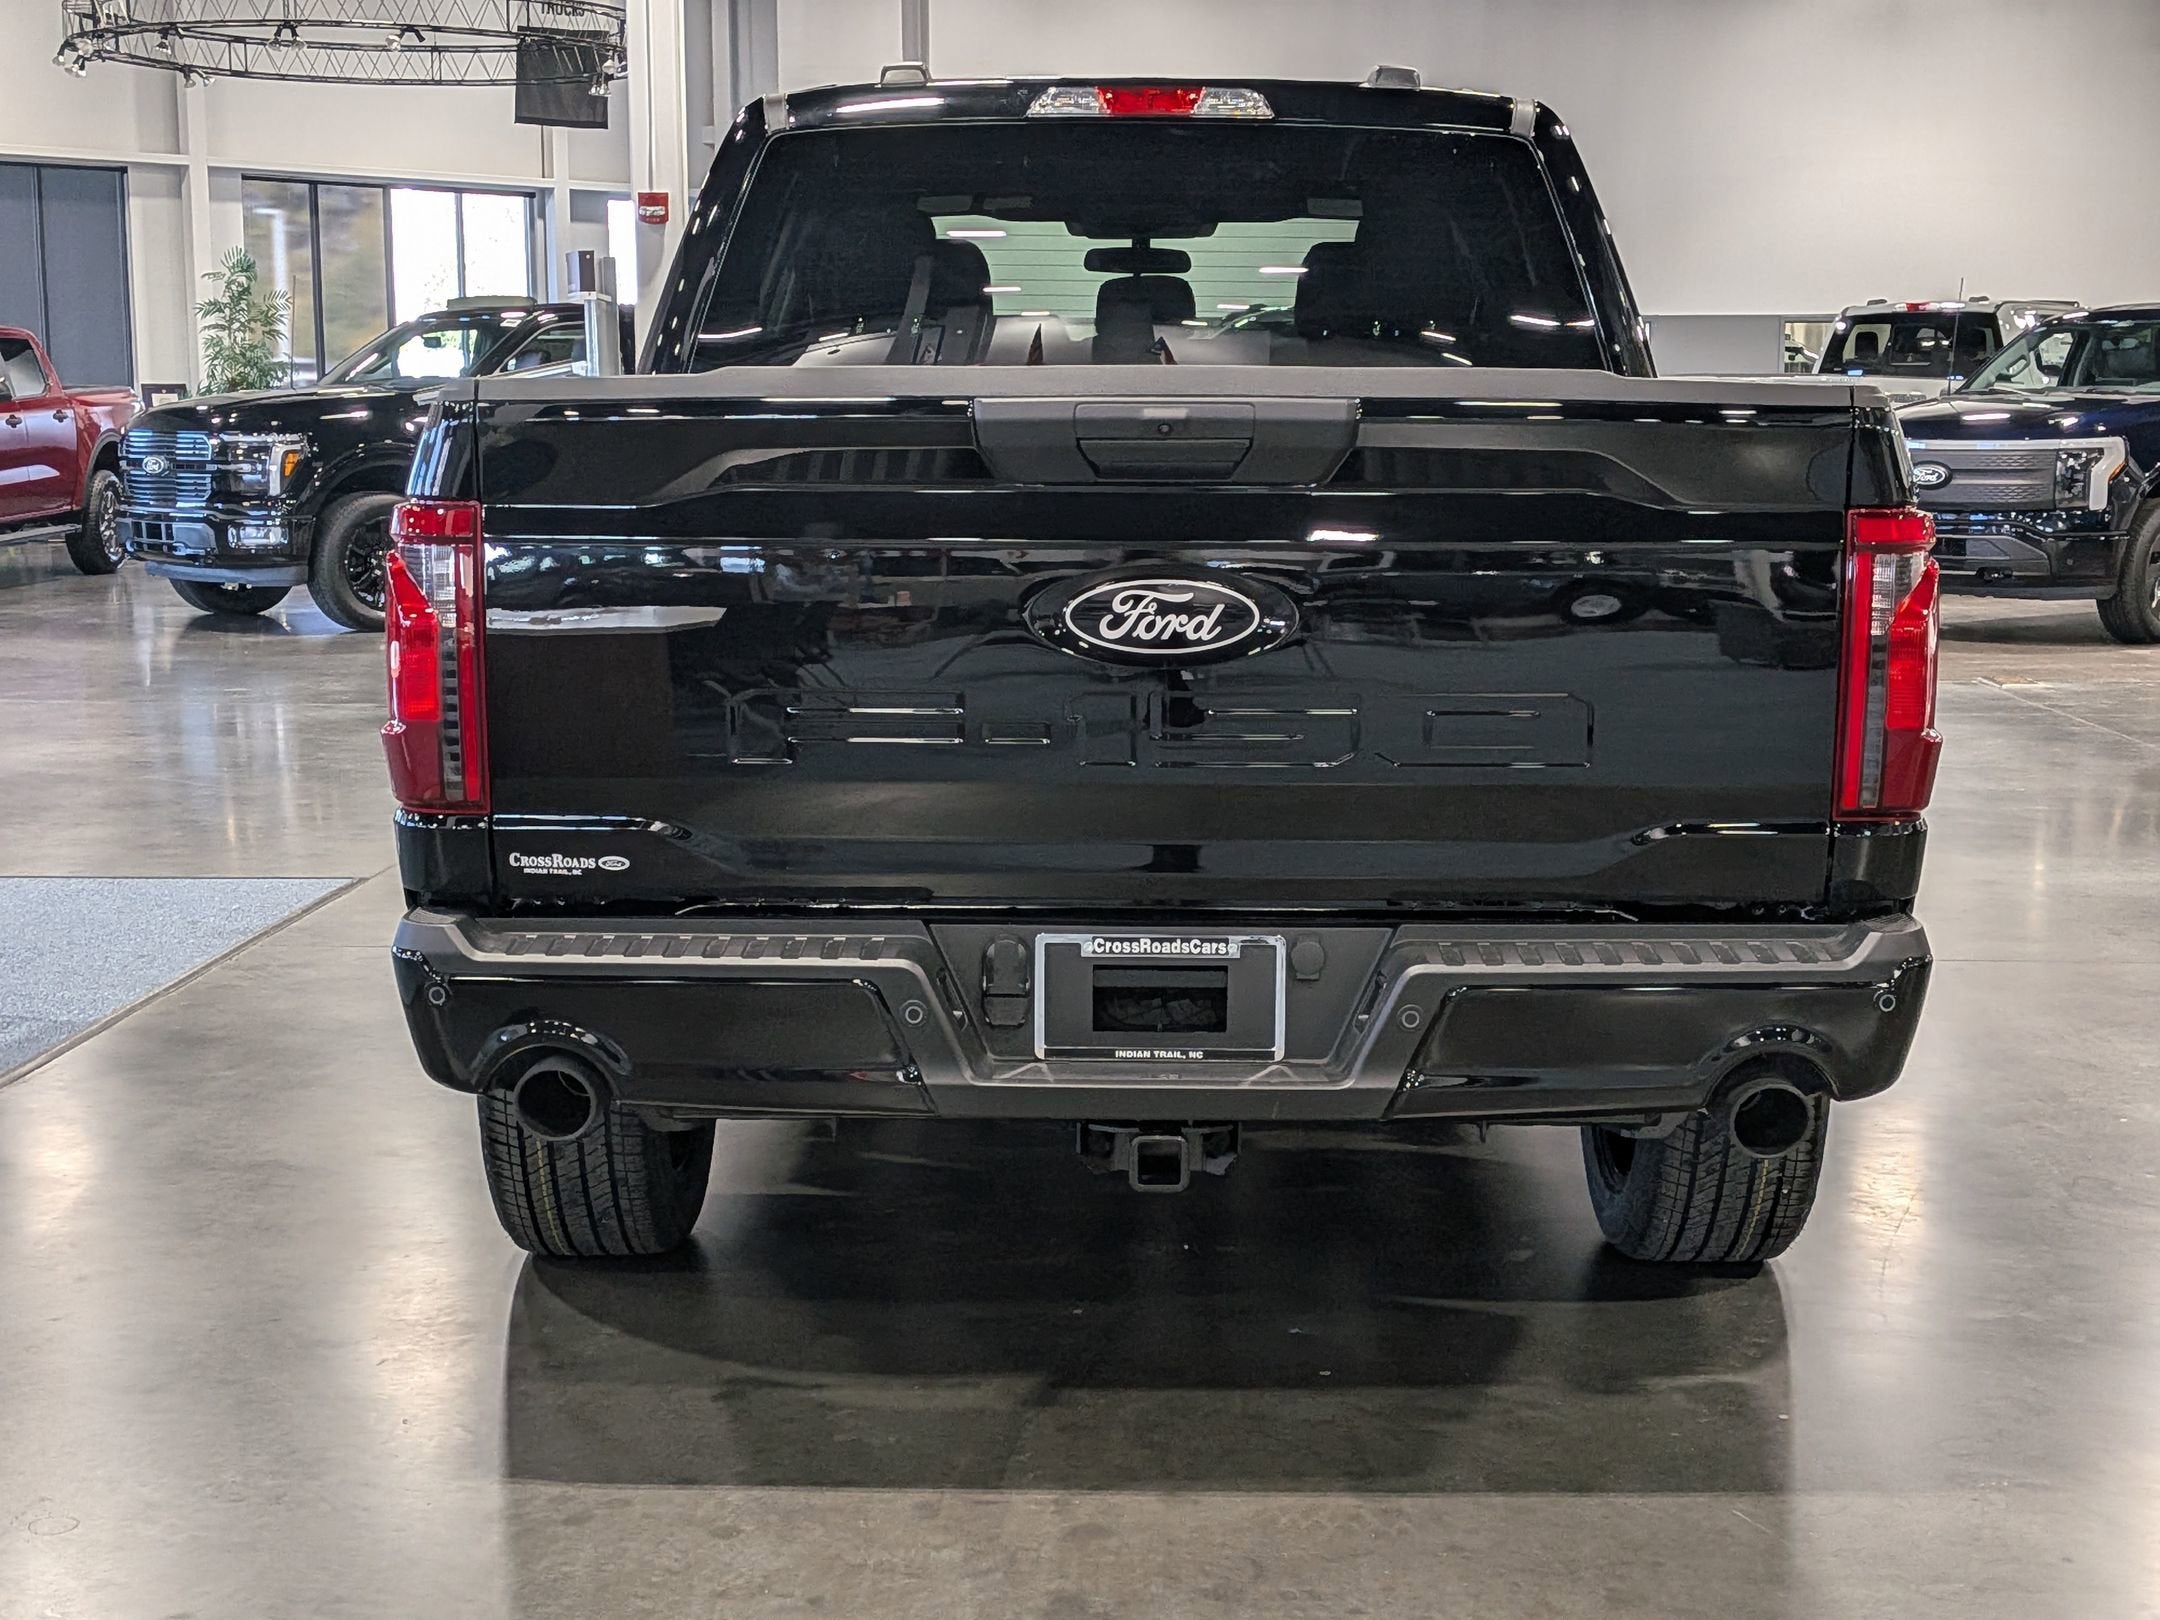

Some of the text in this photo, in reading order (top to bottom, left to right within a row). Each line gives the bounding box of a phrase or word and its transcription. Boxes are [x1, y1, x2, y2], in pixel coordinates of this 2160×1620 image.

[1100, 589, 1226, 640] Ford
[1094, 938, 1227, 954] CrossRoadsCars
[1115, 1050, 1204, 1059] INDIAN TRAIL, NC
